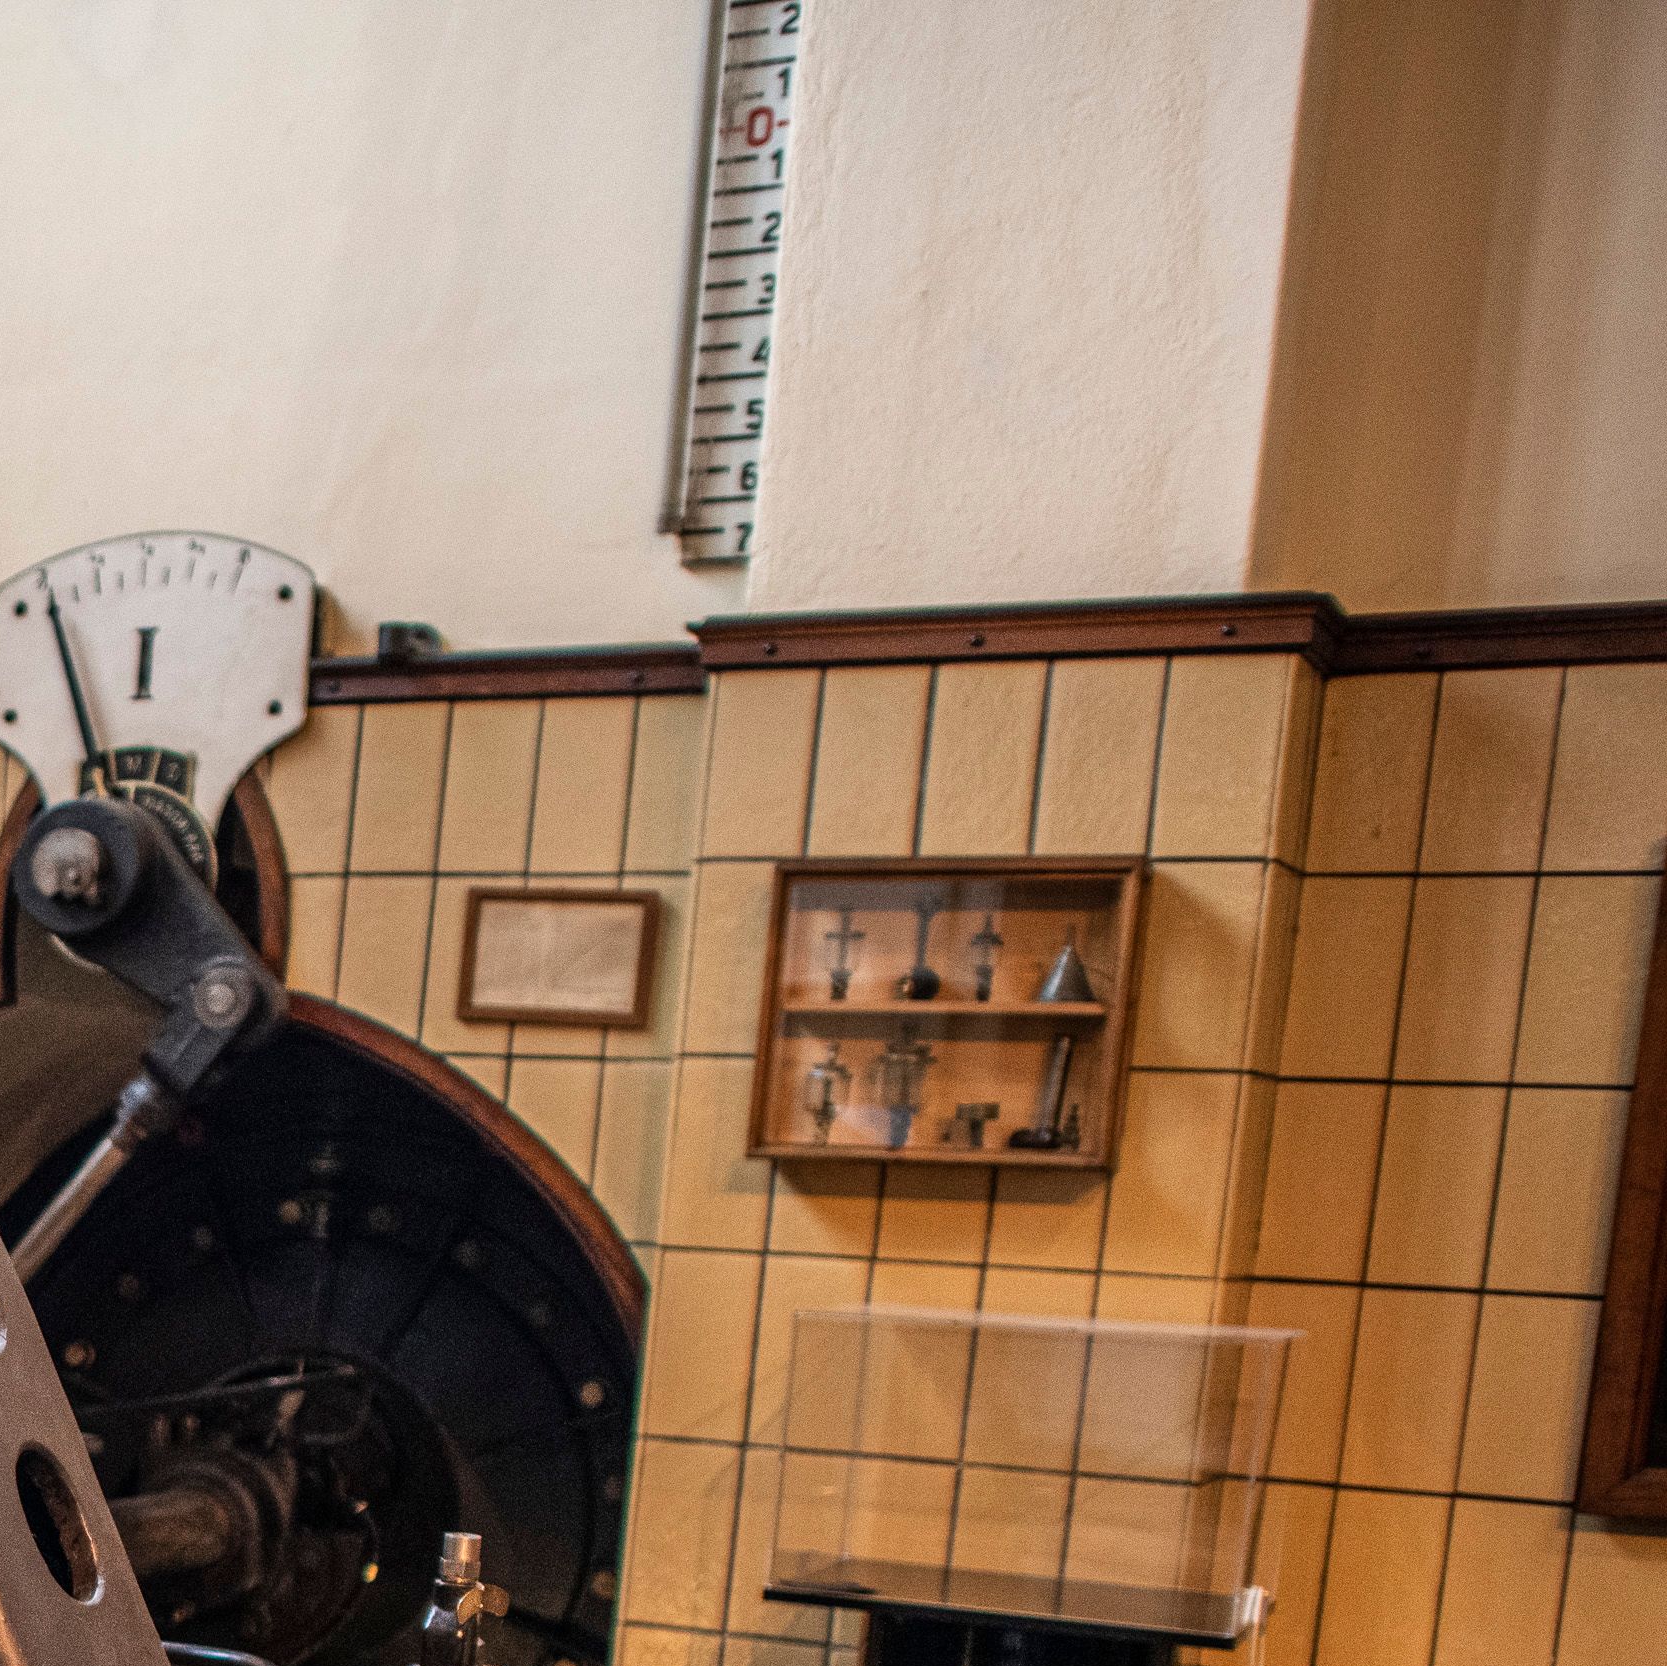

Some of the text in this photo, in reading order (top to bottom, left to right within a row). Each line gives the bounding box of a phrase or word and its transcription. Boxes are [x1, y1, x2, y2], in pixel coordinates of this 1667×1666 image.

[781, 3, 801, 35] 2
[778, 67, 791, 98] 1
[747, 107, 774, 147] 0
[771, 150, 784, 179] 1
[762, 211, 782, 242] 2
[758, 272, 776, 304] 3
[746, 398, 763, 430] 5
[741, 461, 758, 490] 6
[737, 522, 753, 551] 7
